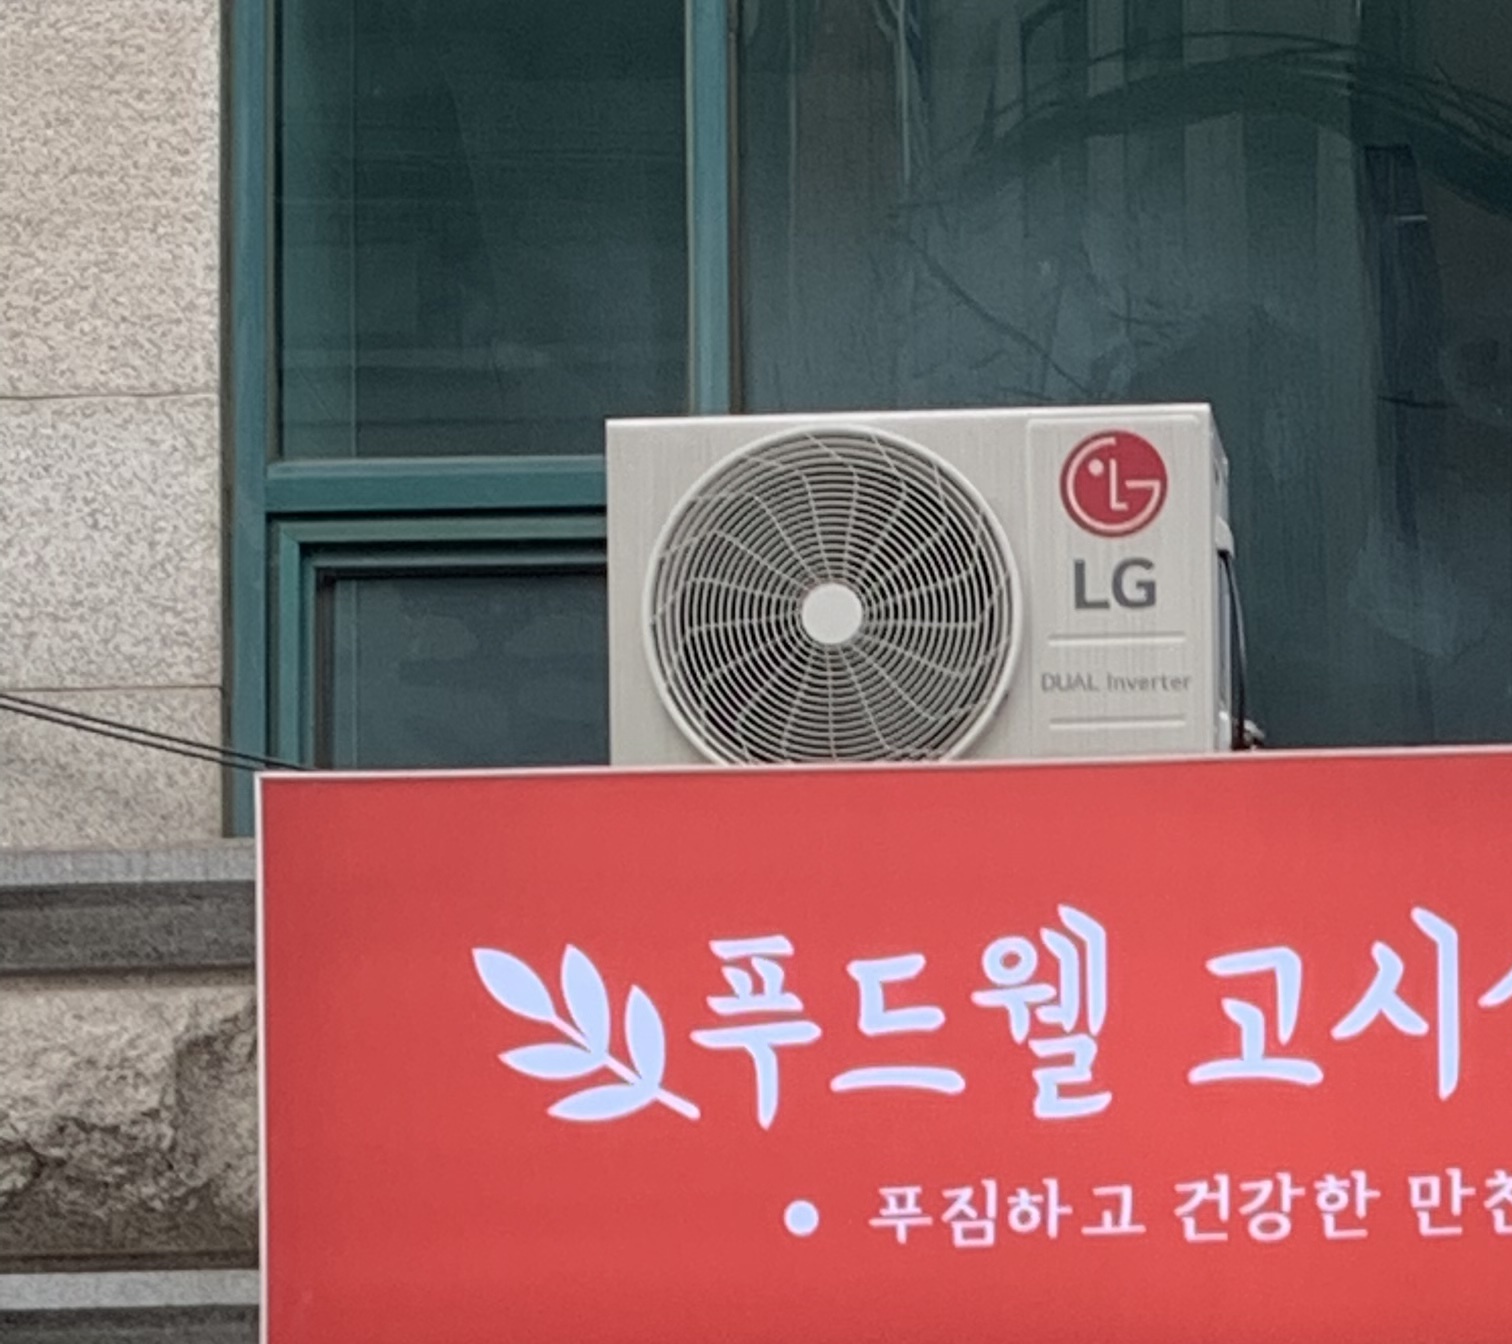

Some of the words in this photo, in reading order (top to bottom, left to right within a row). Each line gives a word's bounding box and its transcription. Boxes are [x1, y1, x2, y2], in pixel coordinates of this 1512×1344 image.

[1072, 557, 1157, 610] LG
[1041, 671, 1099, 692] DUAL
[1106, 671, 1192, 692] Inverter
[690, 902, 1112, 1130] 푸드웰
[867, 1176, 1147, 1248] 푸짐하고
[1174, 1170, 1381, 1243] 건강한
